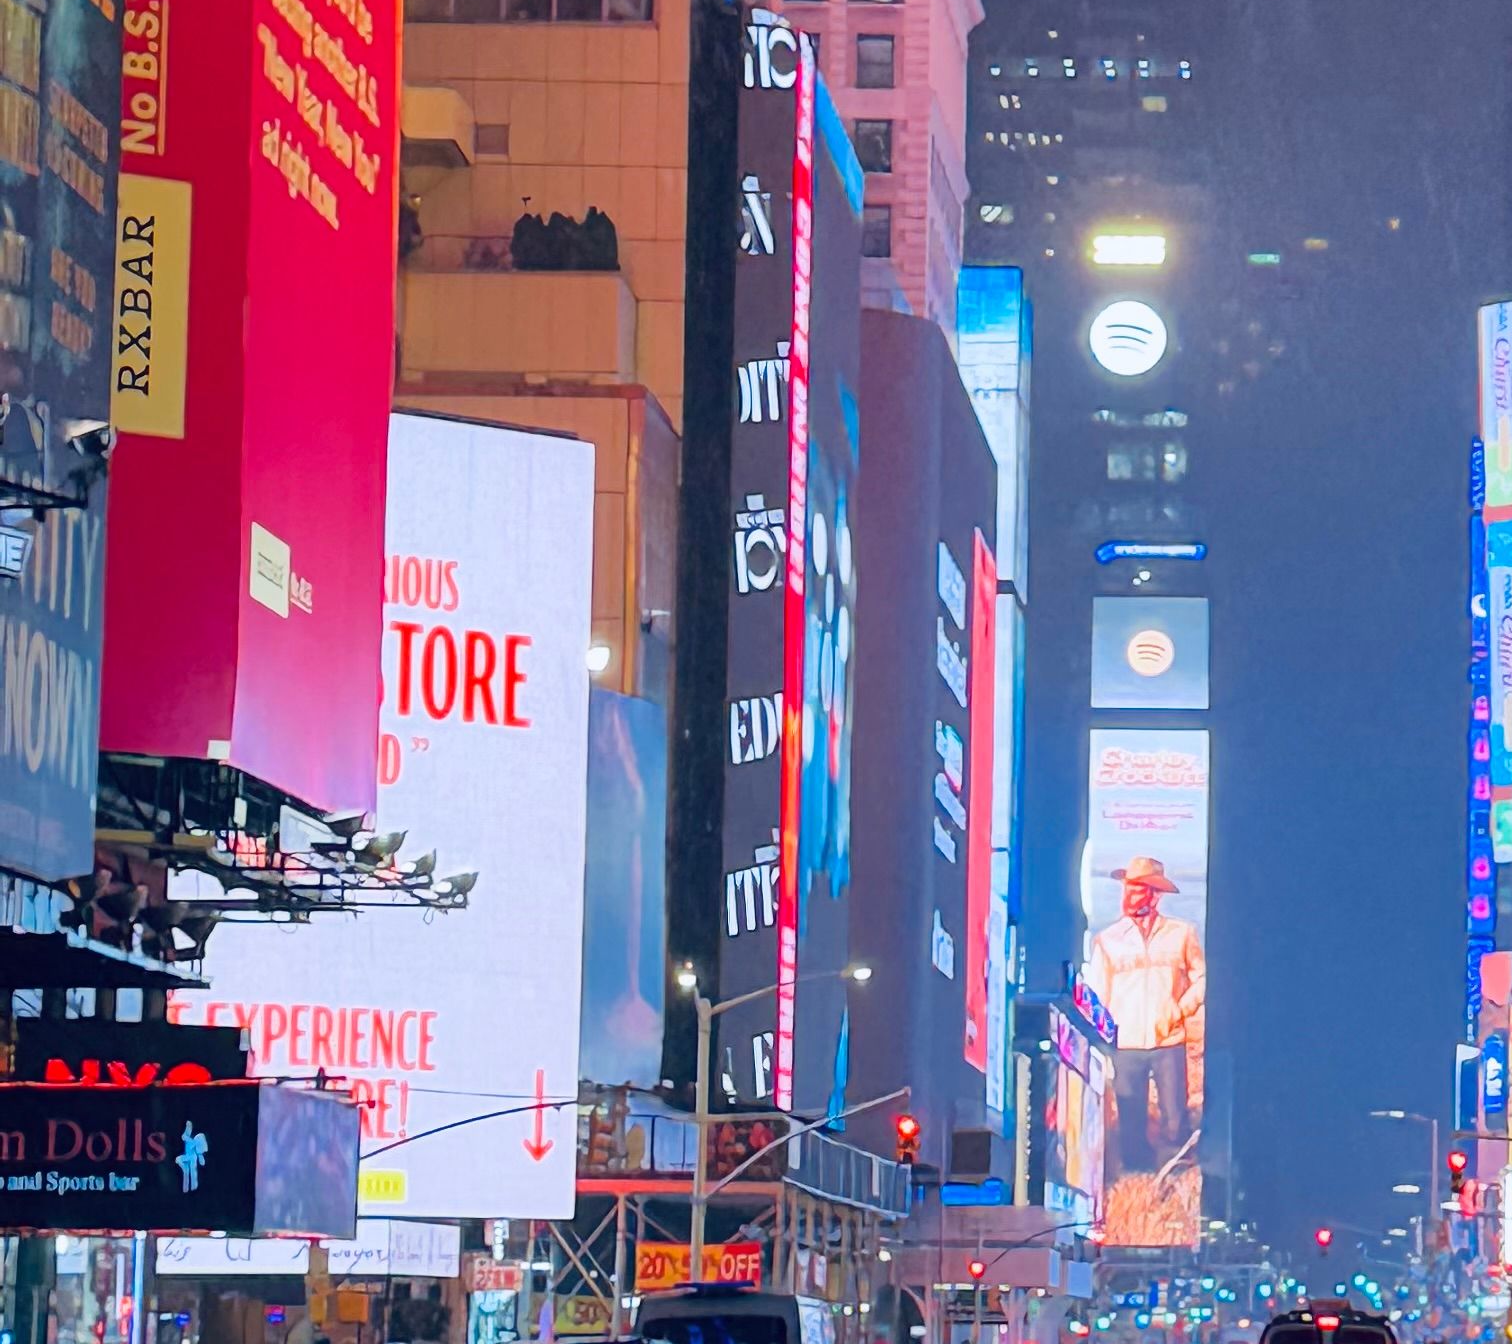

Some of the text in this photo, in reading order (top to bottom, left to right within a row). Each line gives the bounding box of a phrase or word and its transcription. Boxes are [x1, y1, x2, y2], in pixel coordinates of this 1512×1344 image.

[119, 97, 157, 154] No
[118, 215, 155, 396] RXBAR
[387, 554, 459, 613] IOUS
[388, 619, 533, 729] TORE
[47, 1118, 167, 1163] Dolls
[46, 1172, 105, 1196] Sports
